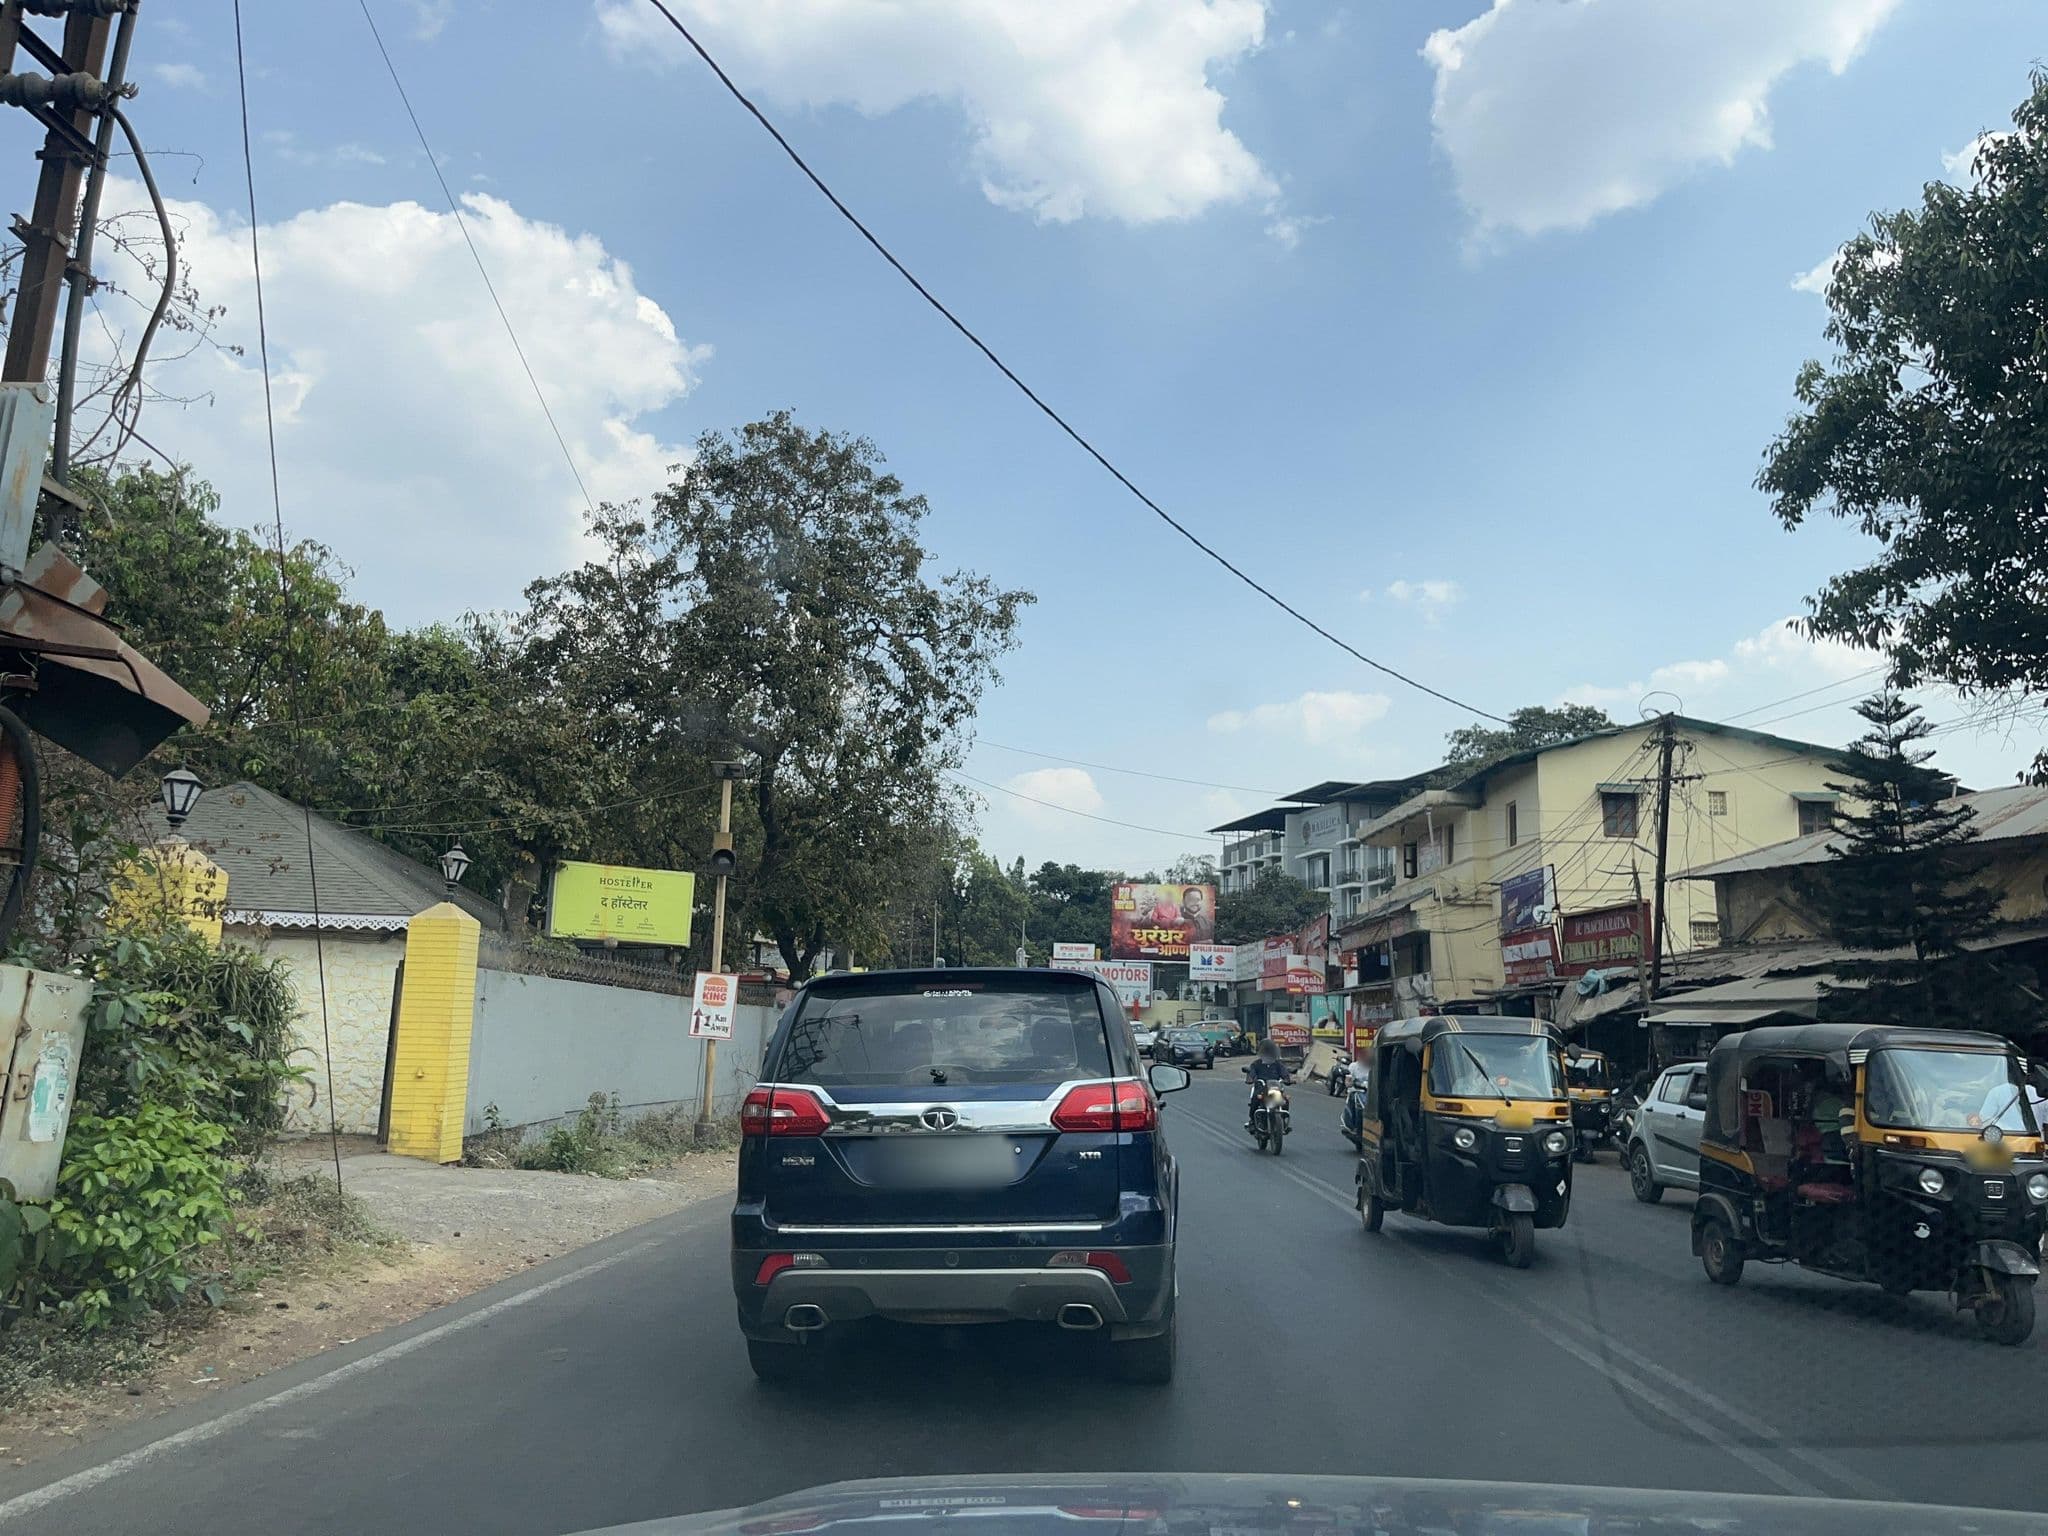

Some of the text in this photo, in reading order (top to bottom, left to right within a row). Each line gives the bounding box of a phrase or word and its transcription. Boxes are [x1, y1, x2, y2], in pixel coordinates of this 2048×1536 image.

[601, 895, 648, 910] द हॉस्टेलर
[1102, 968, 1149, 981] MOTORS
[702, 992, 727, 1001] KING
